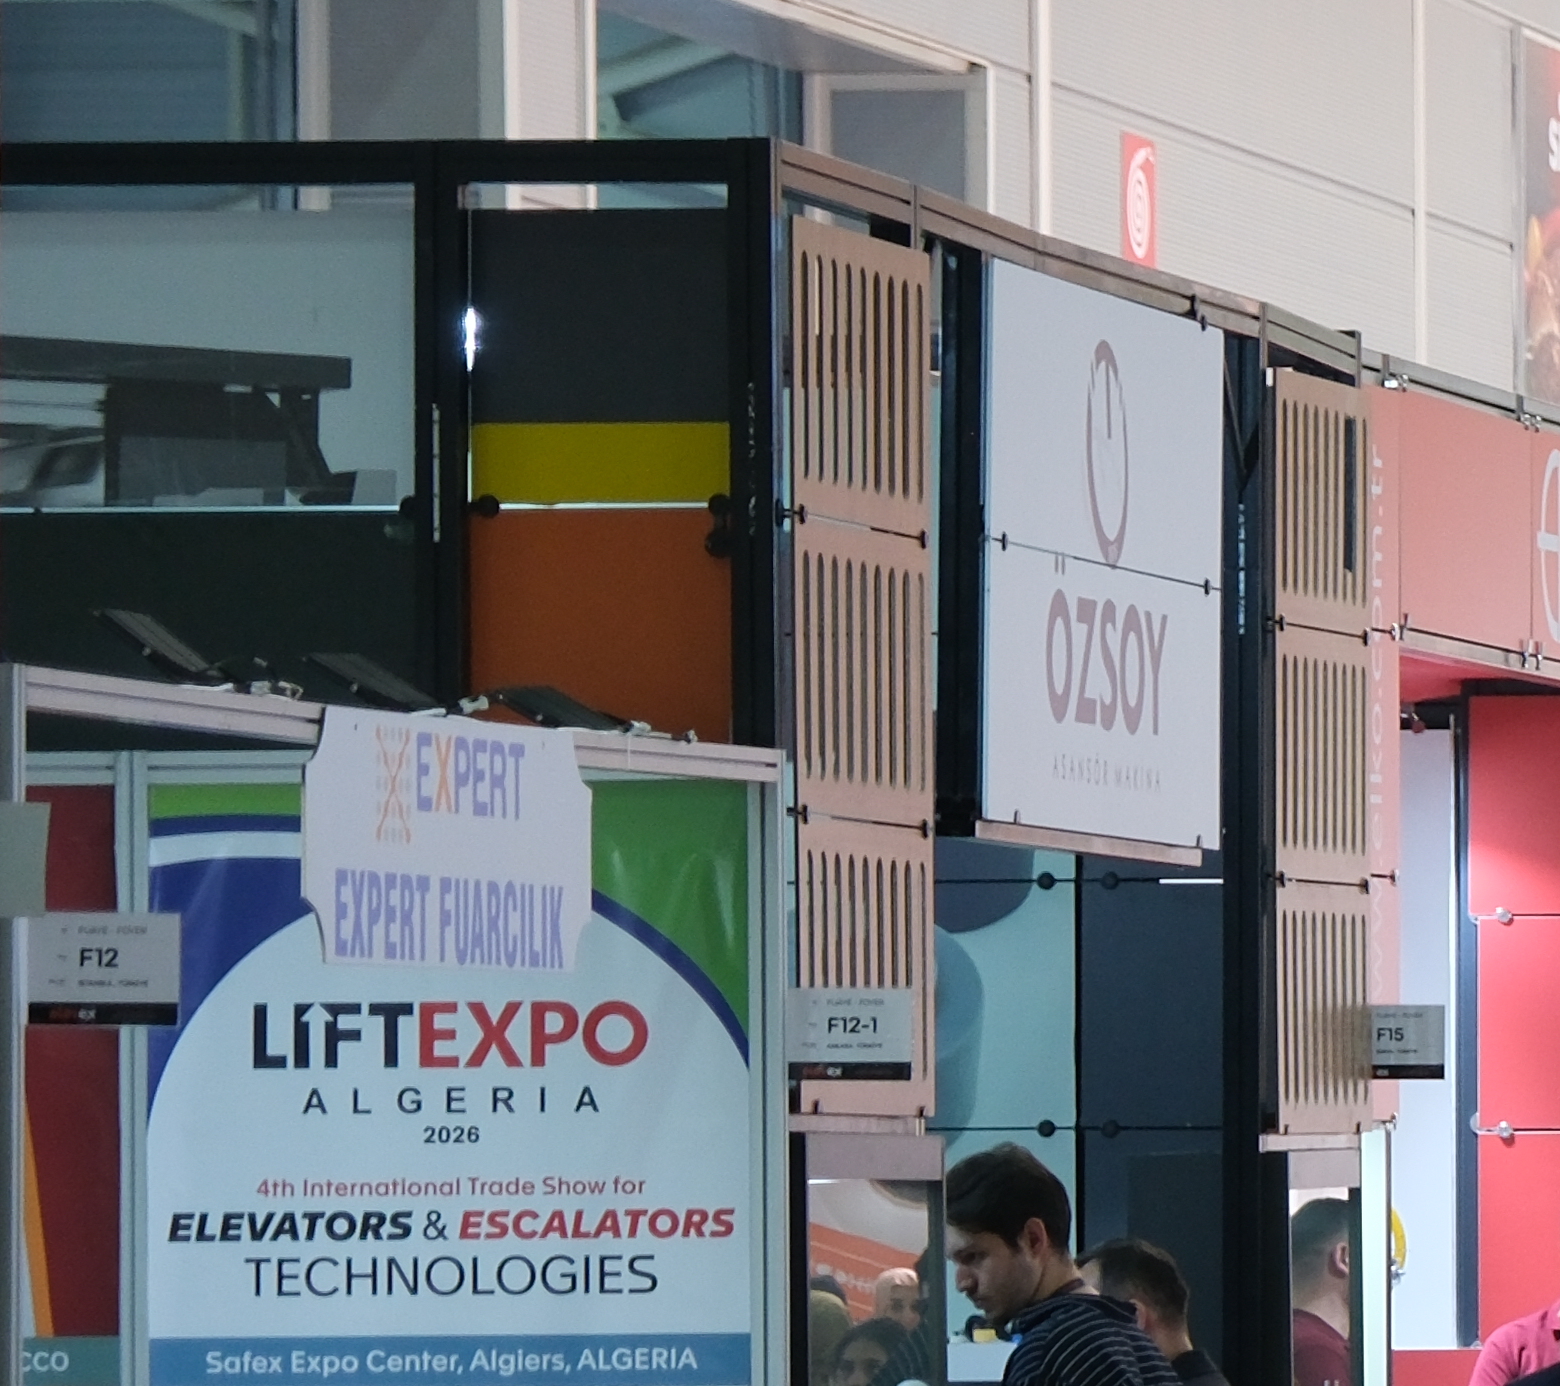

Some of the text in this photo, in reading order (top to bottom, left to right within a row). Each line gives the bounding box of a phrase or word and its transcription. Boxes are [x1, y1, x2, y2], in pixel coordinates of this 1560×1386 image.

[1045, 552, 1168, 736] ÖZSOY
[416, 731, 526, 821] EXPERT
[334, 867, 564, 970] EXPERT FUARCILIK
[78, 946, 119, 968] F12
[827, 1016, 878, 1035] F12-1
[1376, 1026, 1405, 1042] F15
[302, 1086, 600, 1115] ALGERIA
[423, 1126, 480, 1145] 2026
[256, 1174, 646, 1198] 4th International Trade Show for
[167, 1208, 736, 1242] ELEVATORS & ESCALATORS
[244, 1255, 659, 1298] TECHNOLOGIES
[206, 1346, 698, 1379] Safex Expo Center, Algiers, ALGERIA
